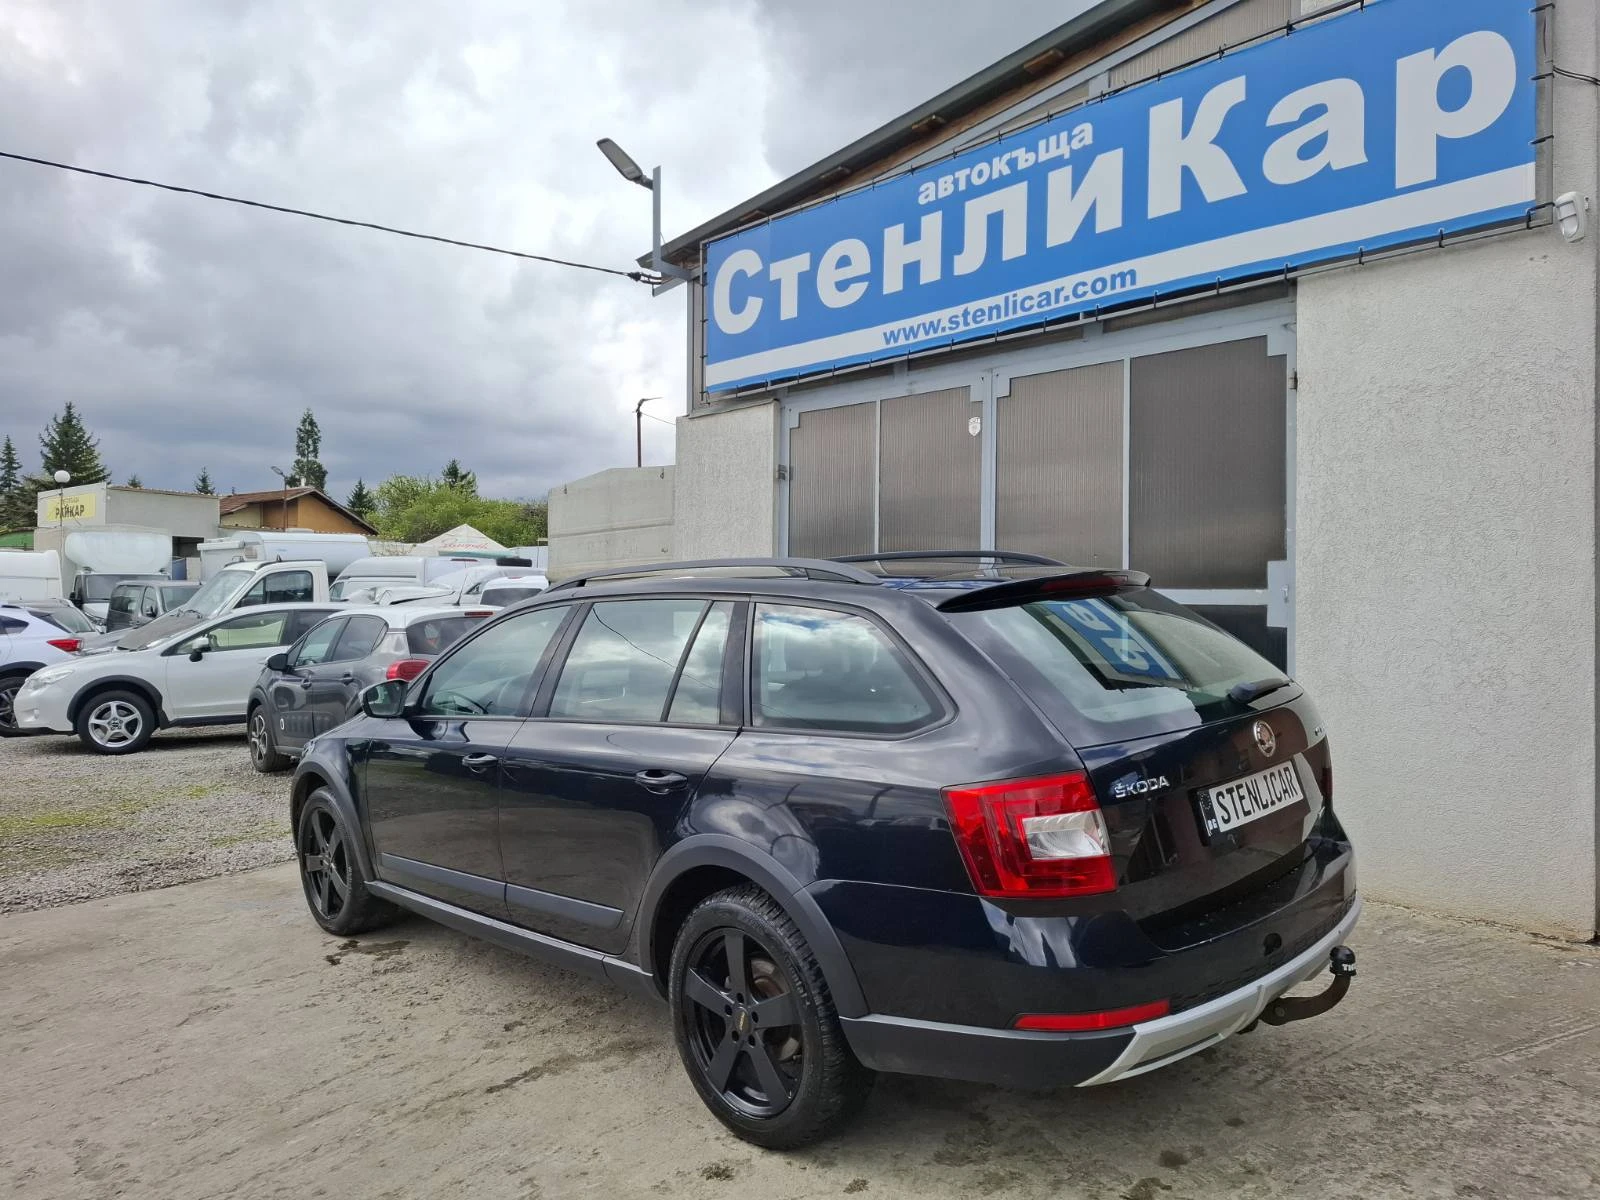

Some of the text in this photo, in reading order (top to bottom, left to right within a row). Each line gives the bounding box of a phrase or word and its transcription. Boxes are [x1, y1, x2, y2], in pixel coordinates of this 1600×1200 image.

[713, 30, 1517, 335] СтенлиКар
[918, 122, 1094, 205] автокъща
[882, 268, 1137, 346] www.stenlicar.com
[1113, 775, 1170, 799] ŠKODA
[1215, 765, 1299, 825] STENLICAR
